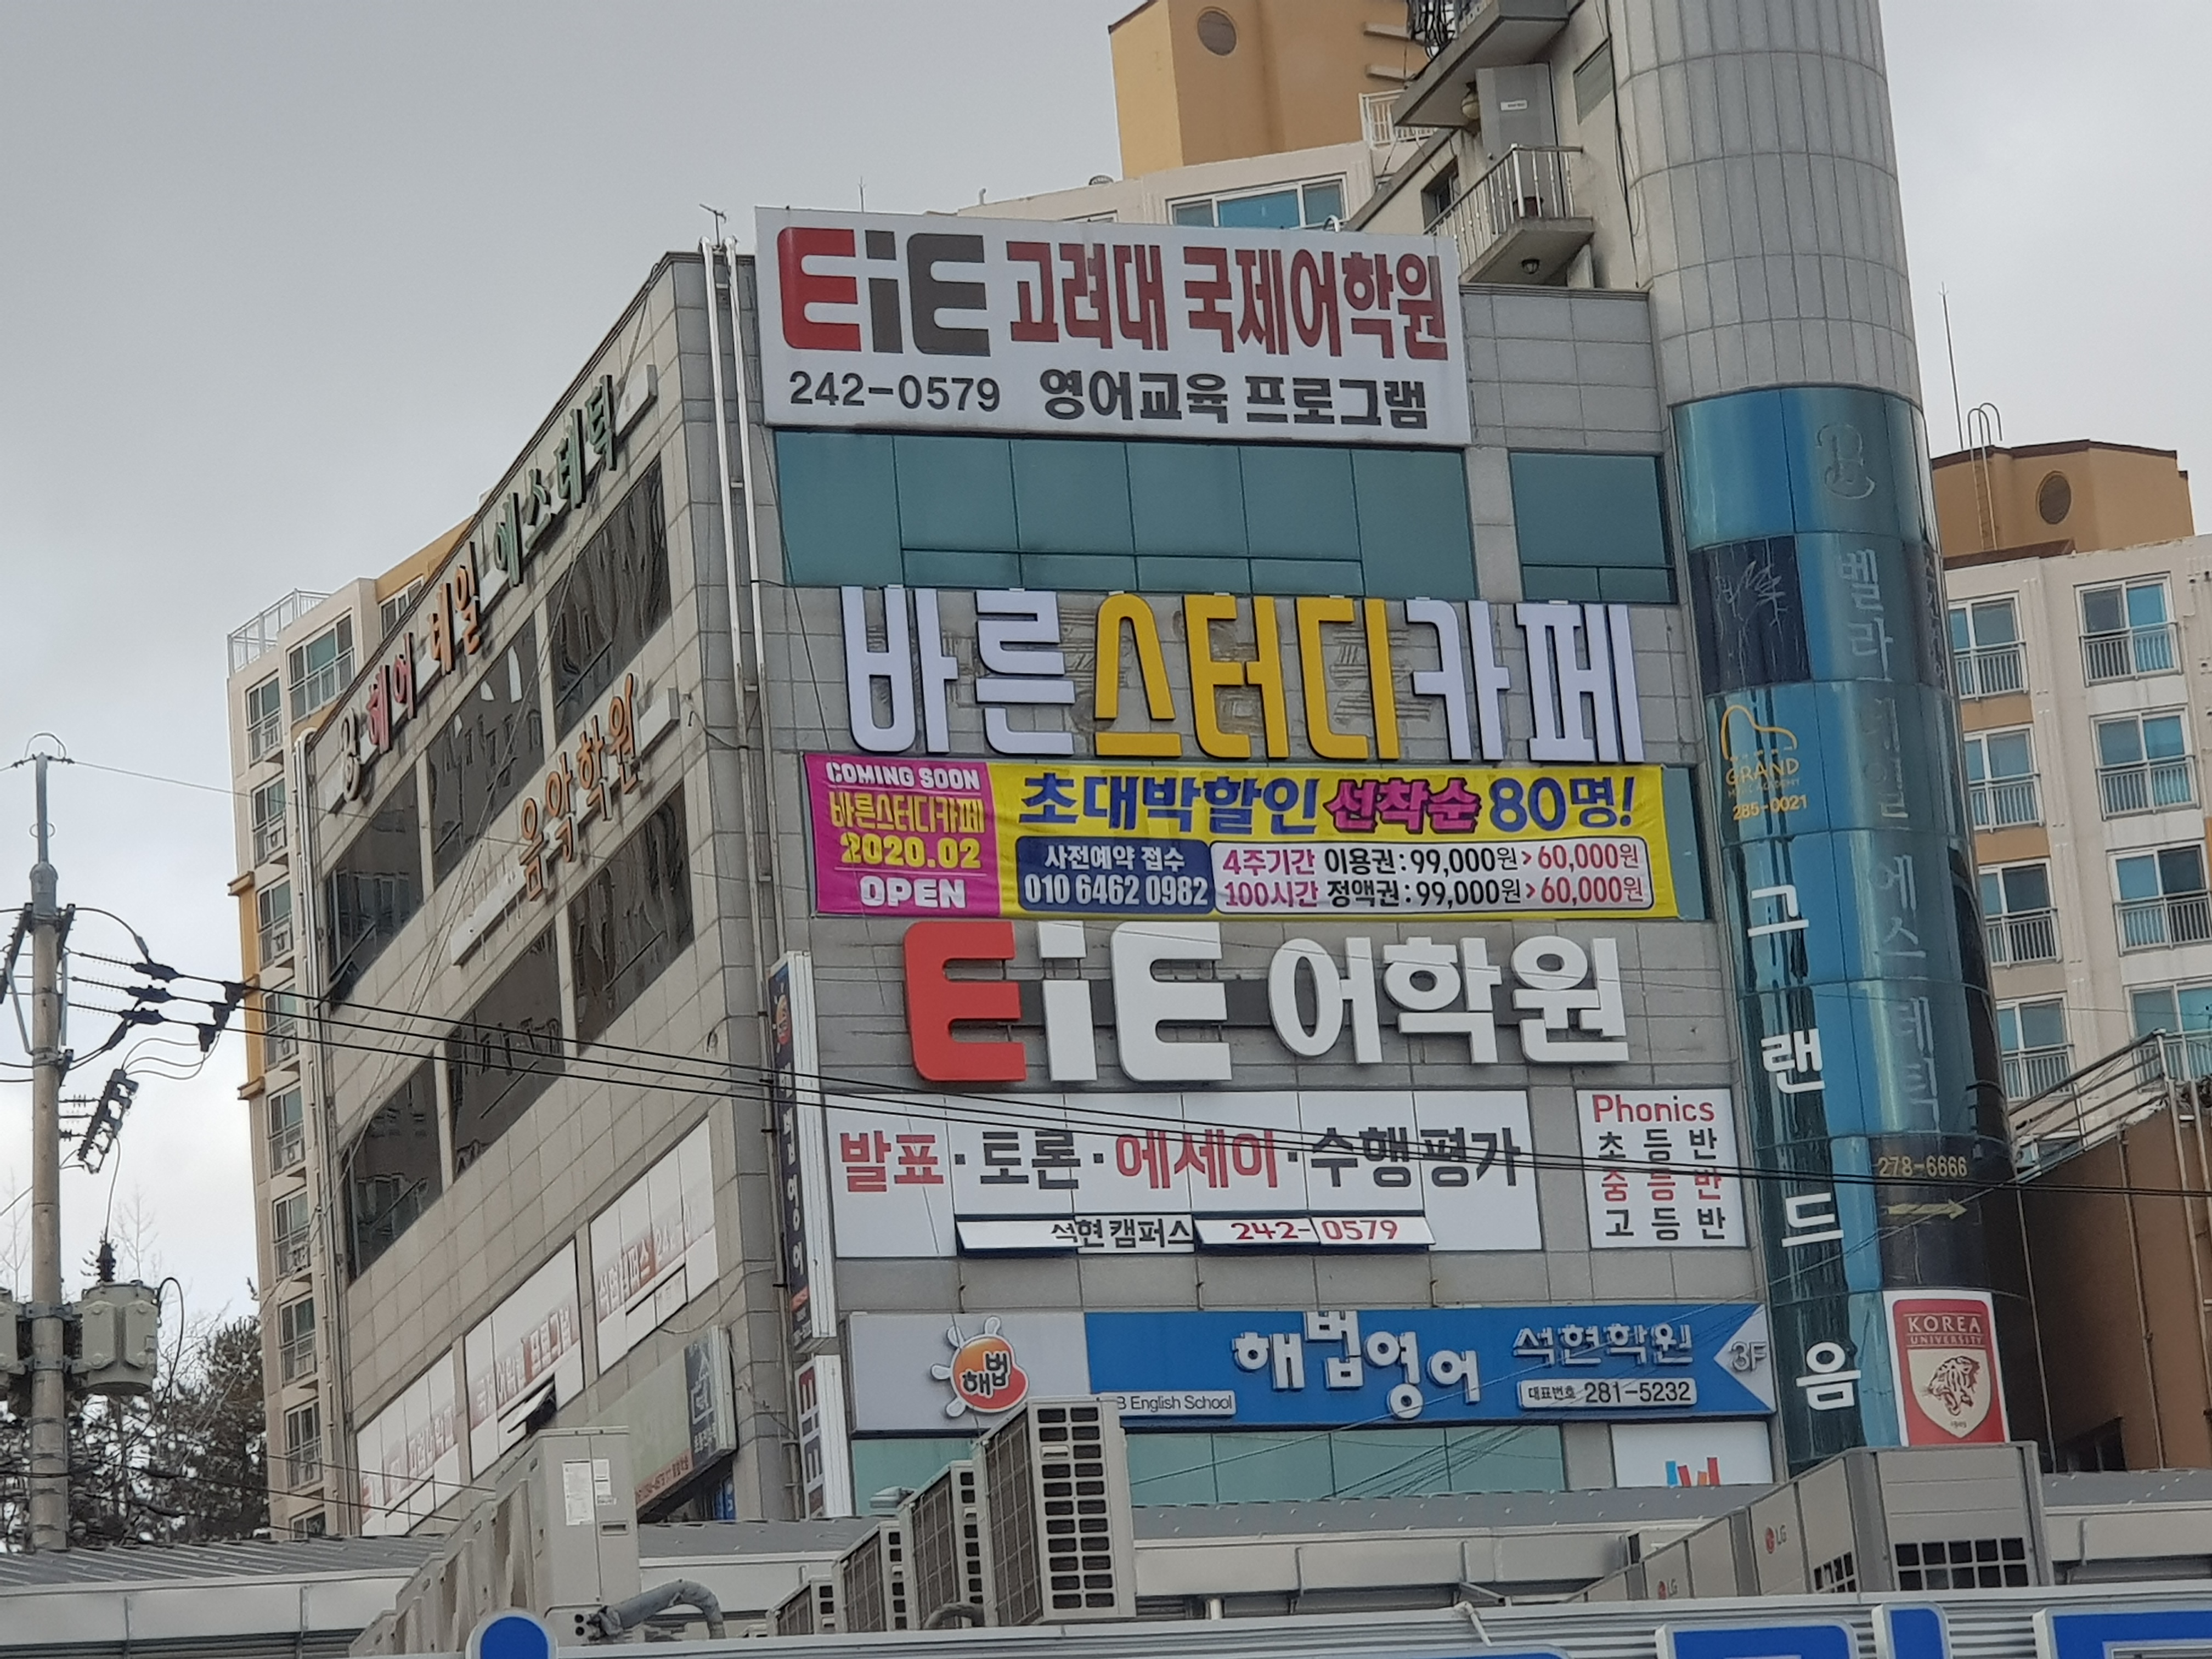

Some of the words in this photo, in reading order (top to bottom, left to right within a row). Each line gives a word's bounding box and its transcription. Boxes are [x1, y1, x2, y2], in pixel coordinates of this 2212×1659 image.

[1006, 240, 1169, 351] 고려대
[1183, 245, 1448, 360] 국제어학원
[789, 370, 1001, 411] 242-0579
[1039, 367, 1229, 424] 영어교육
[1245, 375, 1427, 430] 프로그램
[826, 761, 915, 787] COMING
[919, 768, 980, 791] SOON
[1725, 758, 1799, 785] GRAND
[519, 673, 641, 901] 음악학원
[828, 791, 986, 834] 바른스터디카페
[1018, 772, 1320, 835] 초대박할인
[1323, 777, 1482, 835] 선착순
[1489, 776, 1634, 833] 80명!
[1733, 794, 1807, 820] 285-0021
[840, 833, 982, 869] 2020.02
[1045, 843, 1136, 871] 사전예약
[1140, 844, 1186, 872] 접수
[1223, 848, 1315, 876] 4주기간
[860, 876, 966, 909] OPEN
[1224, 881, 1318, 909] 100시간
[1268, 934, 1630, 1065] 어학원
[1592, 1094, 1715, 1123] Phonics
[1876, 1155, 1969, 1179] 278-6666
[1050, 1218, 1193, 1249] 석현캠퍼스
[1908, 1316, 1981, 1333] KOREA
[1513, 1323, 1694, 1366] 석현학원
[1729, 1340, 1768, 1372] 3F
[1910, 1336, 1983, 1344] UNIVERSITY
[1232, 1310, 1480, 1420] 해법영어
[1130, 1395, 1181, 1413] English
[1184, 1395, 1232, 1410] School
[1527, 1385, 1577, 1403] 대표번호
[1583, 1381, 1692, 1403] 281-5232
[1775, 1524, 1787, 1546] LG
